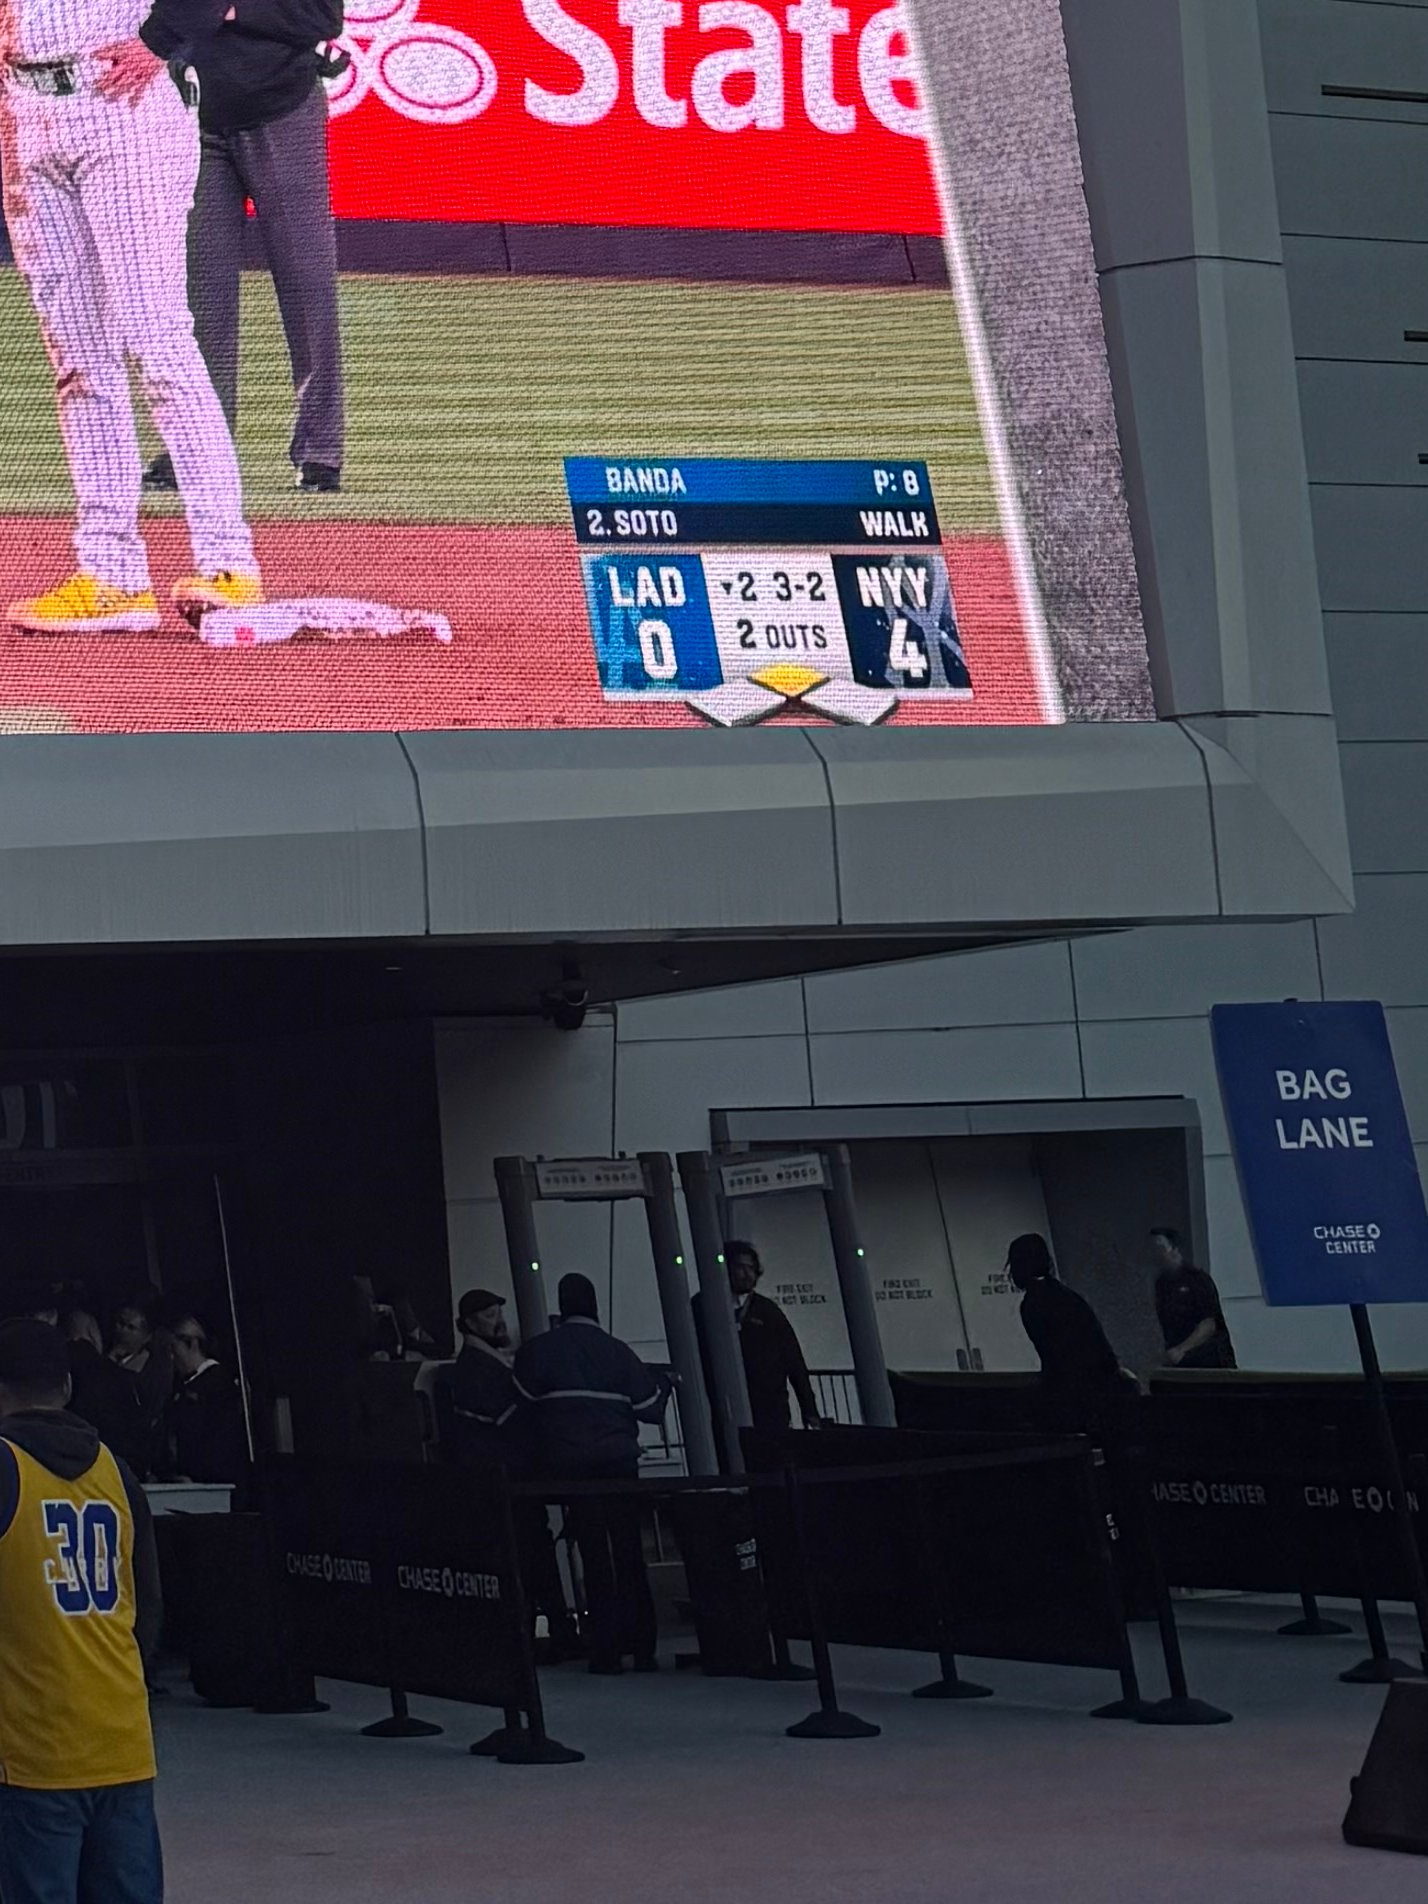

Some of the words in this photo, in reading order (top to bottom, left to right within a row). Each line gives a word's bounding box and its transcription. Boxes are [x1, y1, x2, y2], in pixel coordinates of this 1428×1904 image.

[606, 467, 686, 494] BANDA
[874, 470, 898, 496] P:
[587, 509, 612, 537] 2.
[617, 509, 679, 537] SOTO
[859, 511, 930, 538] WALK
[607, 566, 686, 608] LAD
[736, 571, 758, 602] 2
[772, 571, 826, 603] 3-2
[856, 566, 928, 608] NYY
[638, 619, 680, 680] 0
[736, 618, 758, 650] 2
[766, 624, 829, 650] OUTS
[888, 619, 927, 678] 4
[1275, 1068, 1352, 1100] BAG
[1275, 1116, 1374, 1149] LANE
[1313, 1225, 1365, 1239] CHASE
[1325, 1240, 1376, 1254] CENTER
[1151, 1481, 1192, 1502] ASE
[1210, 1482, 1267, 1505] CENTER
[1303, 1485, 1366, 1510] CHAE
[41, 1498, 121, 1617] 30
[397, 1565, 443, 1594] CHASE
[455, 1571, 501, 1600] CENTER
